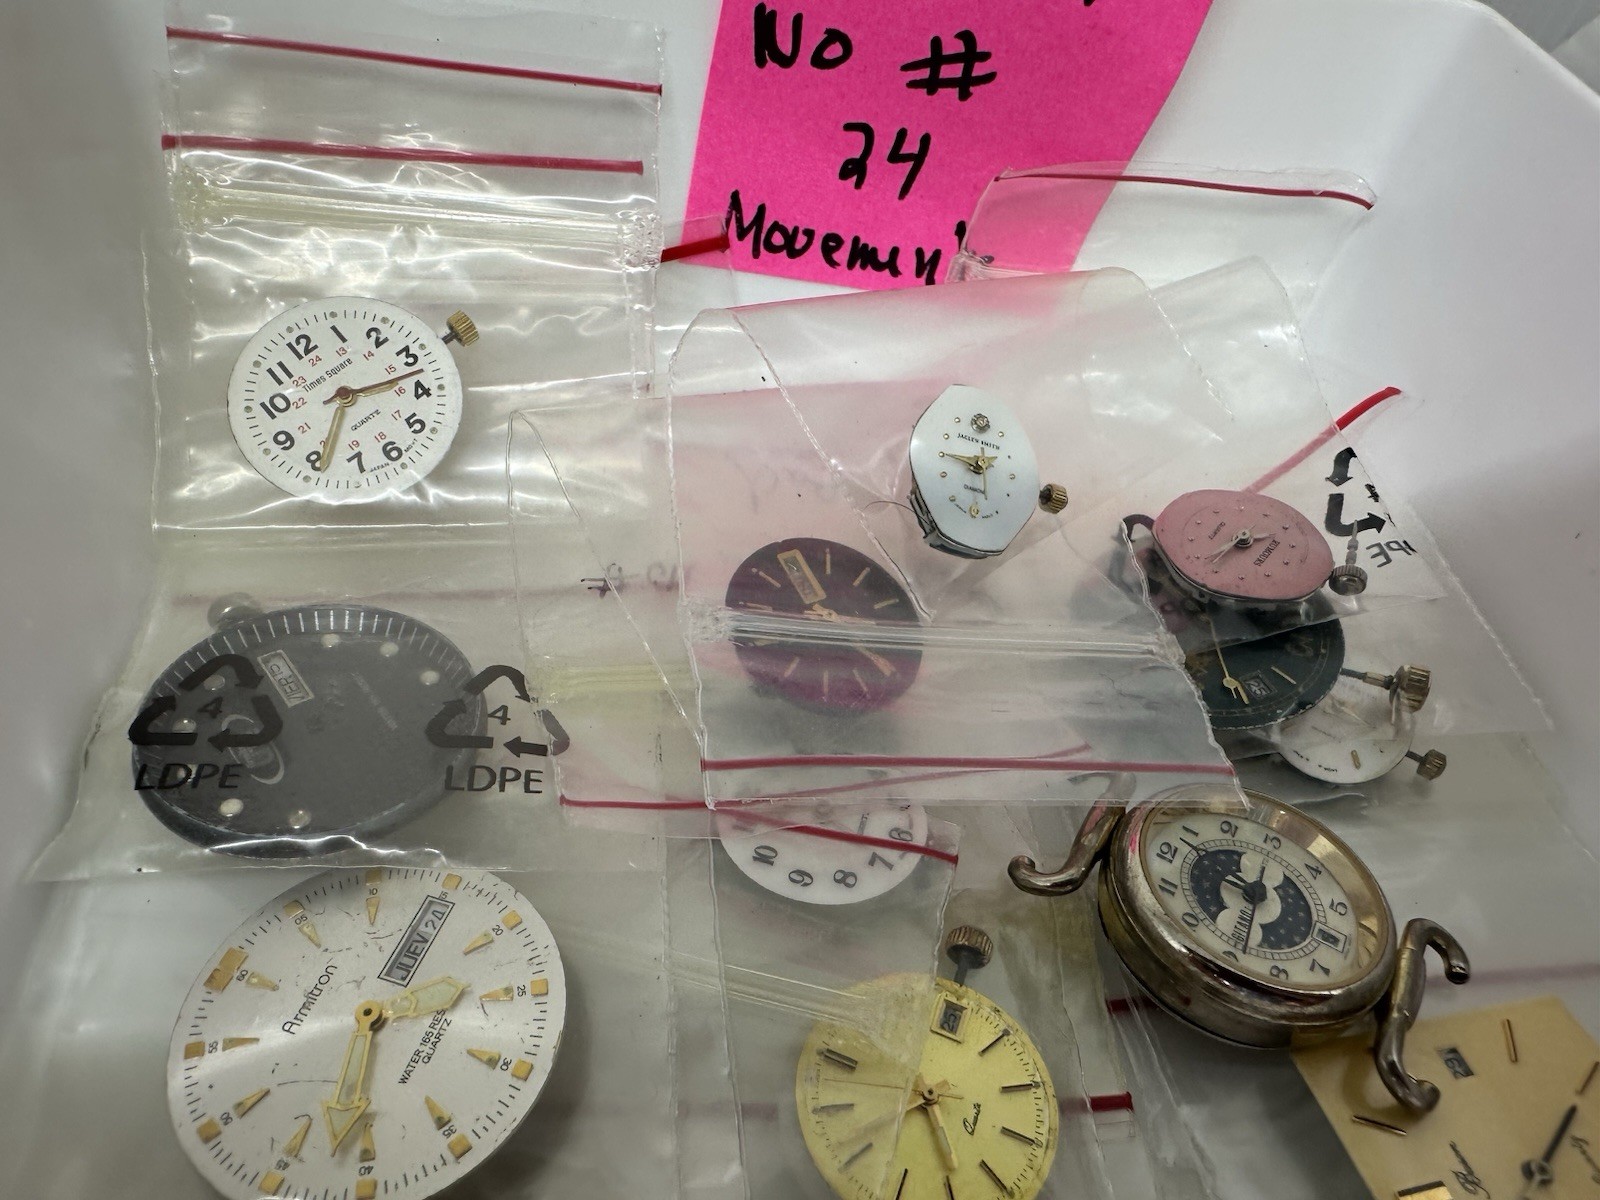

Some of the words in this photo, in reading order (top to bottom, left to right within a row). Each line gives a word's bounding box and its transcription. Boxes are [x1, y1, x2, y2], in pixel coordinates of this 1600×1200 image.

[753, 3, 853, 70] No
[900, 30, 997, 101] #
[838, 122, 931, 200] 24
[330, 325, 348, 344] 1
[365, 327, 389, 349] 2
[286, 333, 318, 361] 12
[335, 347, 348, 357] 13
[363, 350, 375, 361] 14
[395, 345, 418, 367] 3
[308, 354, 322, 367] 24
[384, 364, 397, 375] 15
[266, 361, 294, 386] 11
[292, 375, 307, 387] 23
[302, 375, 327, 394] Times
[325, 357, 353, 379] Square
[395, 386, 407, 397] 16
[413, 379, 432, 401] 4
[260, 392, 291, 420] 10
[292, 397, 307, 410] 22
[350, 409, 381, 431] QUARTZ
[392, 410, 402, 421] 17
[404, 412, 426, 434] 5
[297, 422, 312, 434] 21
[374, 431, 387, 443] 18
[272, 430, 295, 451] 9
[348, 440, 360, 451] 19
[305, 450, 322, 472] 8
[382, 441, 403, 462] 6
[346, 451, 366, 474] 7
[486, 703, 512, 726] 4
[134, 762, 243, 791] LDPE
[444, 764, 544, 794] LDPE
[1219, 820, 1239, 838] 2
[1263, 833, 1282, 850] 3
[752, 845, 778, 866] 10
[867, 851, 894, 871] 7
[1156, 841, 1179, 864] 12
[788, 869, 813, 887] 9
[833, 869, 858, 888] 8
[1304, 862, 1322, 881] 4
[368, 888, 378, 896] 10
[1158, 877, 1179, 897] 11
[1329, 898, 1348, 917] 5
[492, 924, 504, 937] 20
[396, 932, 430, 982] JUEV
[1269, 965, 1289, 980] 8
[1309, 958, 1331, 978] 7
[282, 964, 338, 1034] Armitron
[516, 984, 526, 997] 25
[208, 1041, 219, 1054] 55
[422, 1018, 452, 1065] QUARTZ
[398, 1046, 425, 1085] WATER
[421, 1029, 437, 1049] 165
[500, 1058, 512, 1071] 30
